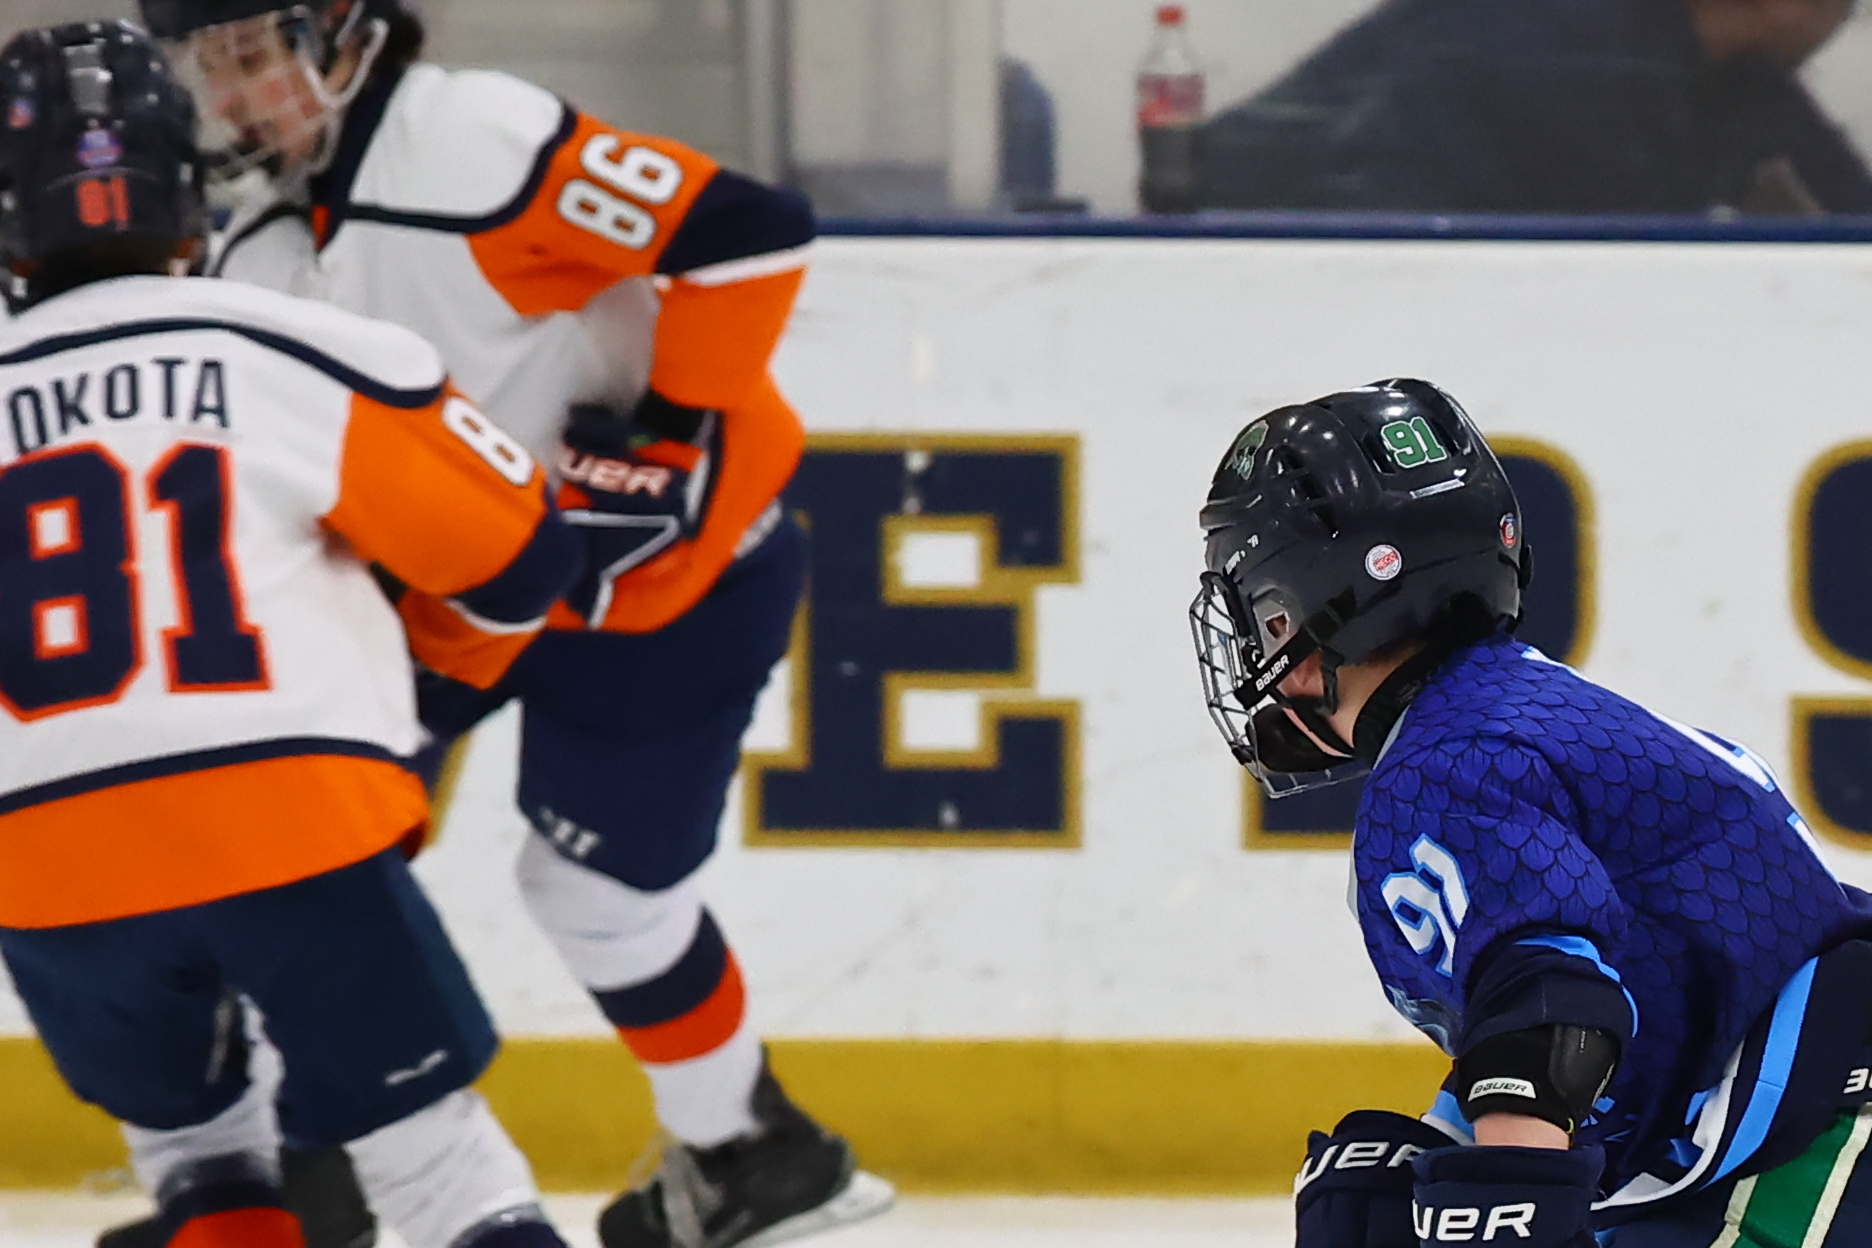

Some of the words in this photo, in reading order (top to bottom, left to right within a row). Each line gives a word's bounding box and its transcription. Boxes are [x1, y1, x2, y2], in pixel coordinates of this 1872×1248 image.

[556, 132, 684, 250] 86
[1381, 416, 1448, 469] 91
[0, 439, 272, 723] 81
[1255, 653, 1290, 692] BAUER
[1380, 832, 1470, 976] 91
[1473, 1082, 1528, 1095] BAUER
[1412, 1199, 1536, 1241] UER
